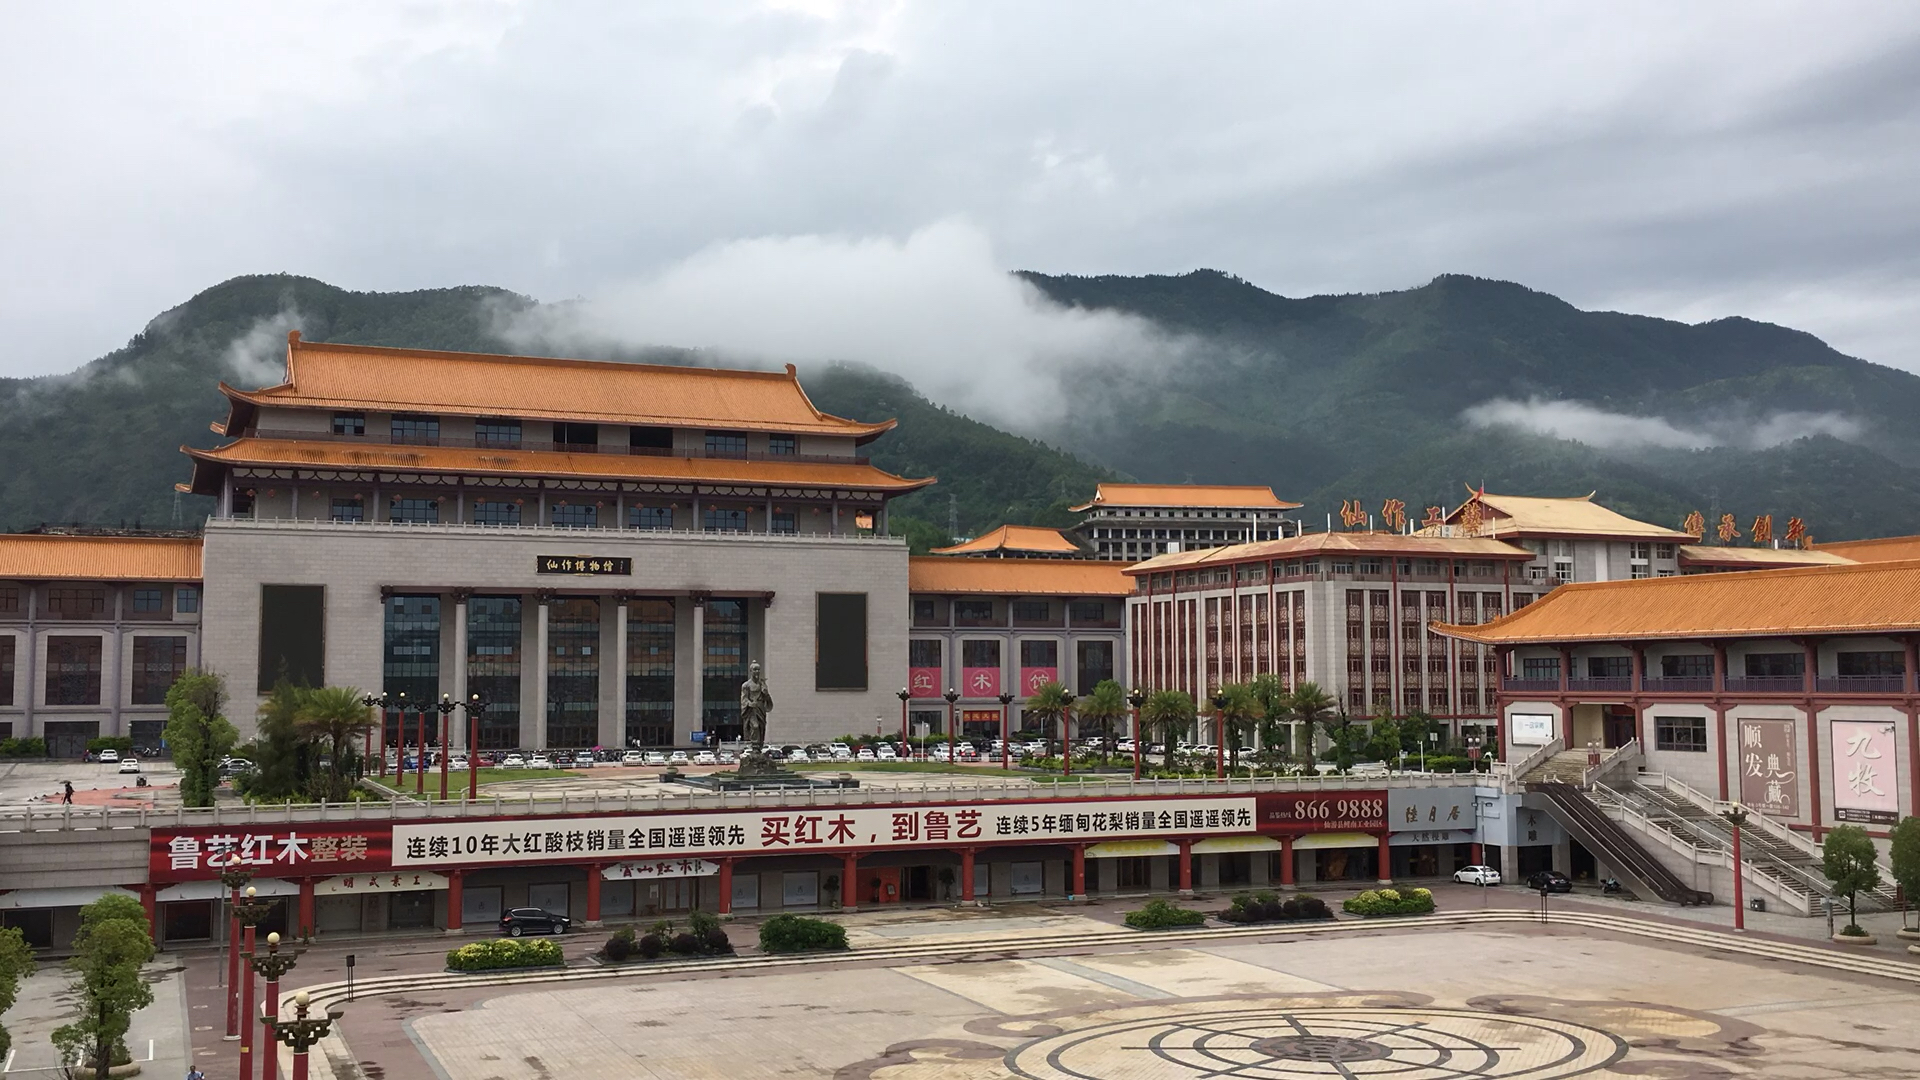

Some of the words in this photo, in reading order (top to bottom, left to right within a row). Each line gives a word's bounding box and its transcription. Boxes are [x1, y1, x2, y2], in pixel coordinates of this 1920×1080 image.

[1744, 725, 1764, 777] 顺发
[405, 823, 745, 859] 连续10年大红酸枝销量全国遥遥领先
[996, 808, 1251, 835] 连续5年缅甸花梨销量全国遥遥领先
[1294, 800, 1330, 820] 866
[1337, 799, 1383, 819] 9888
